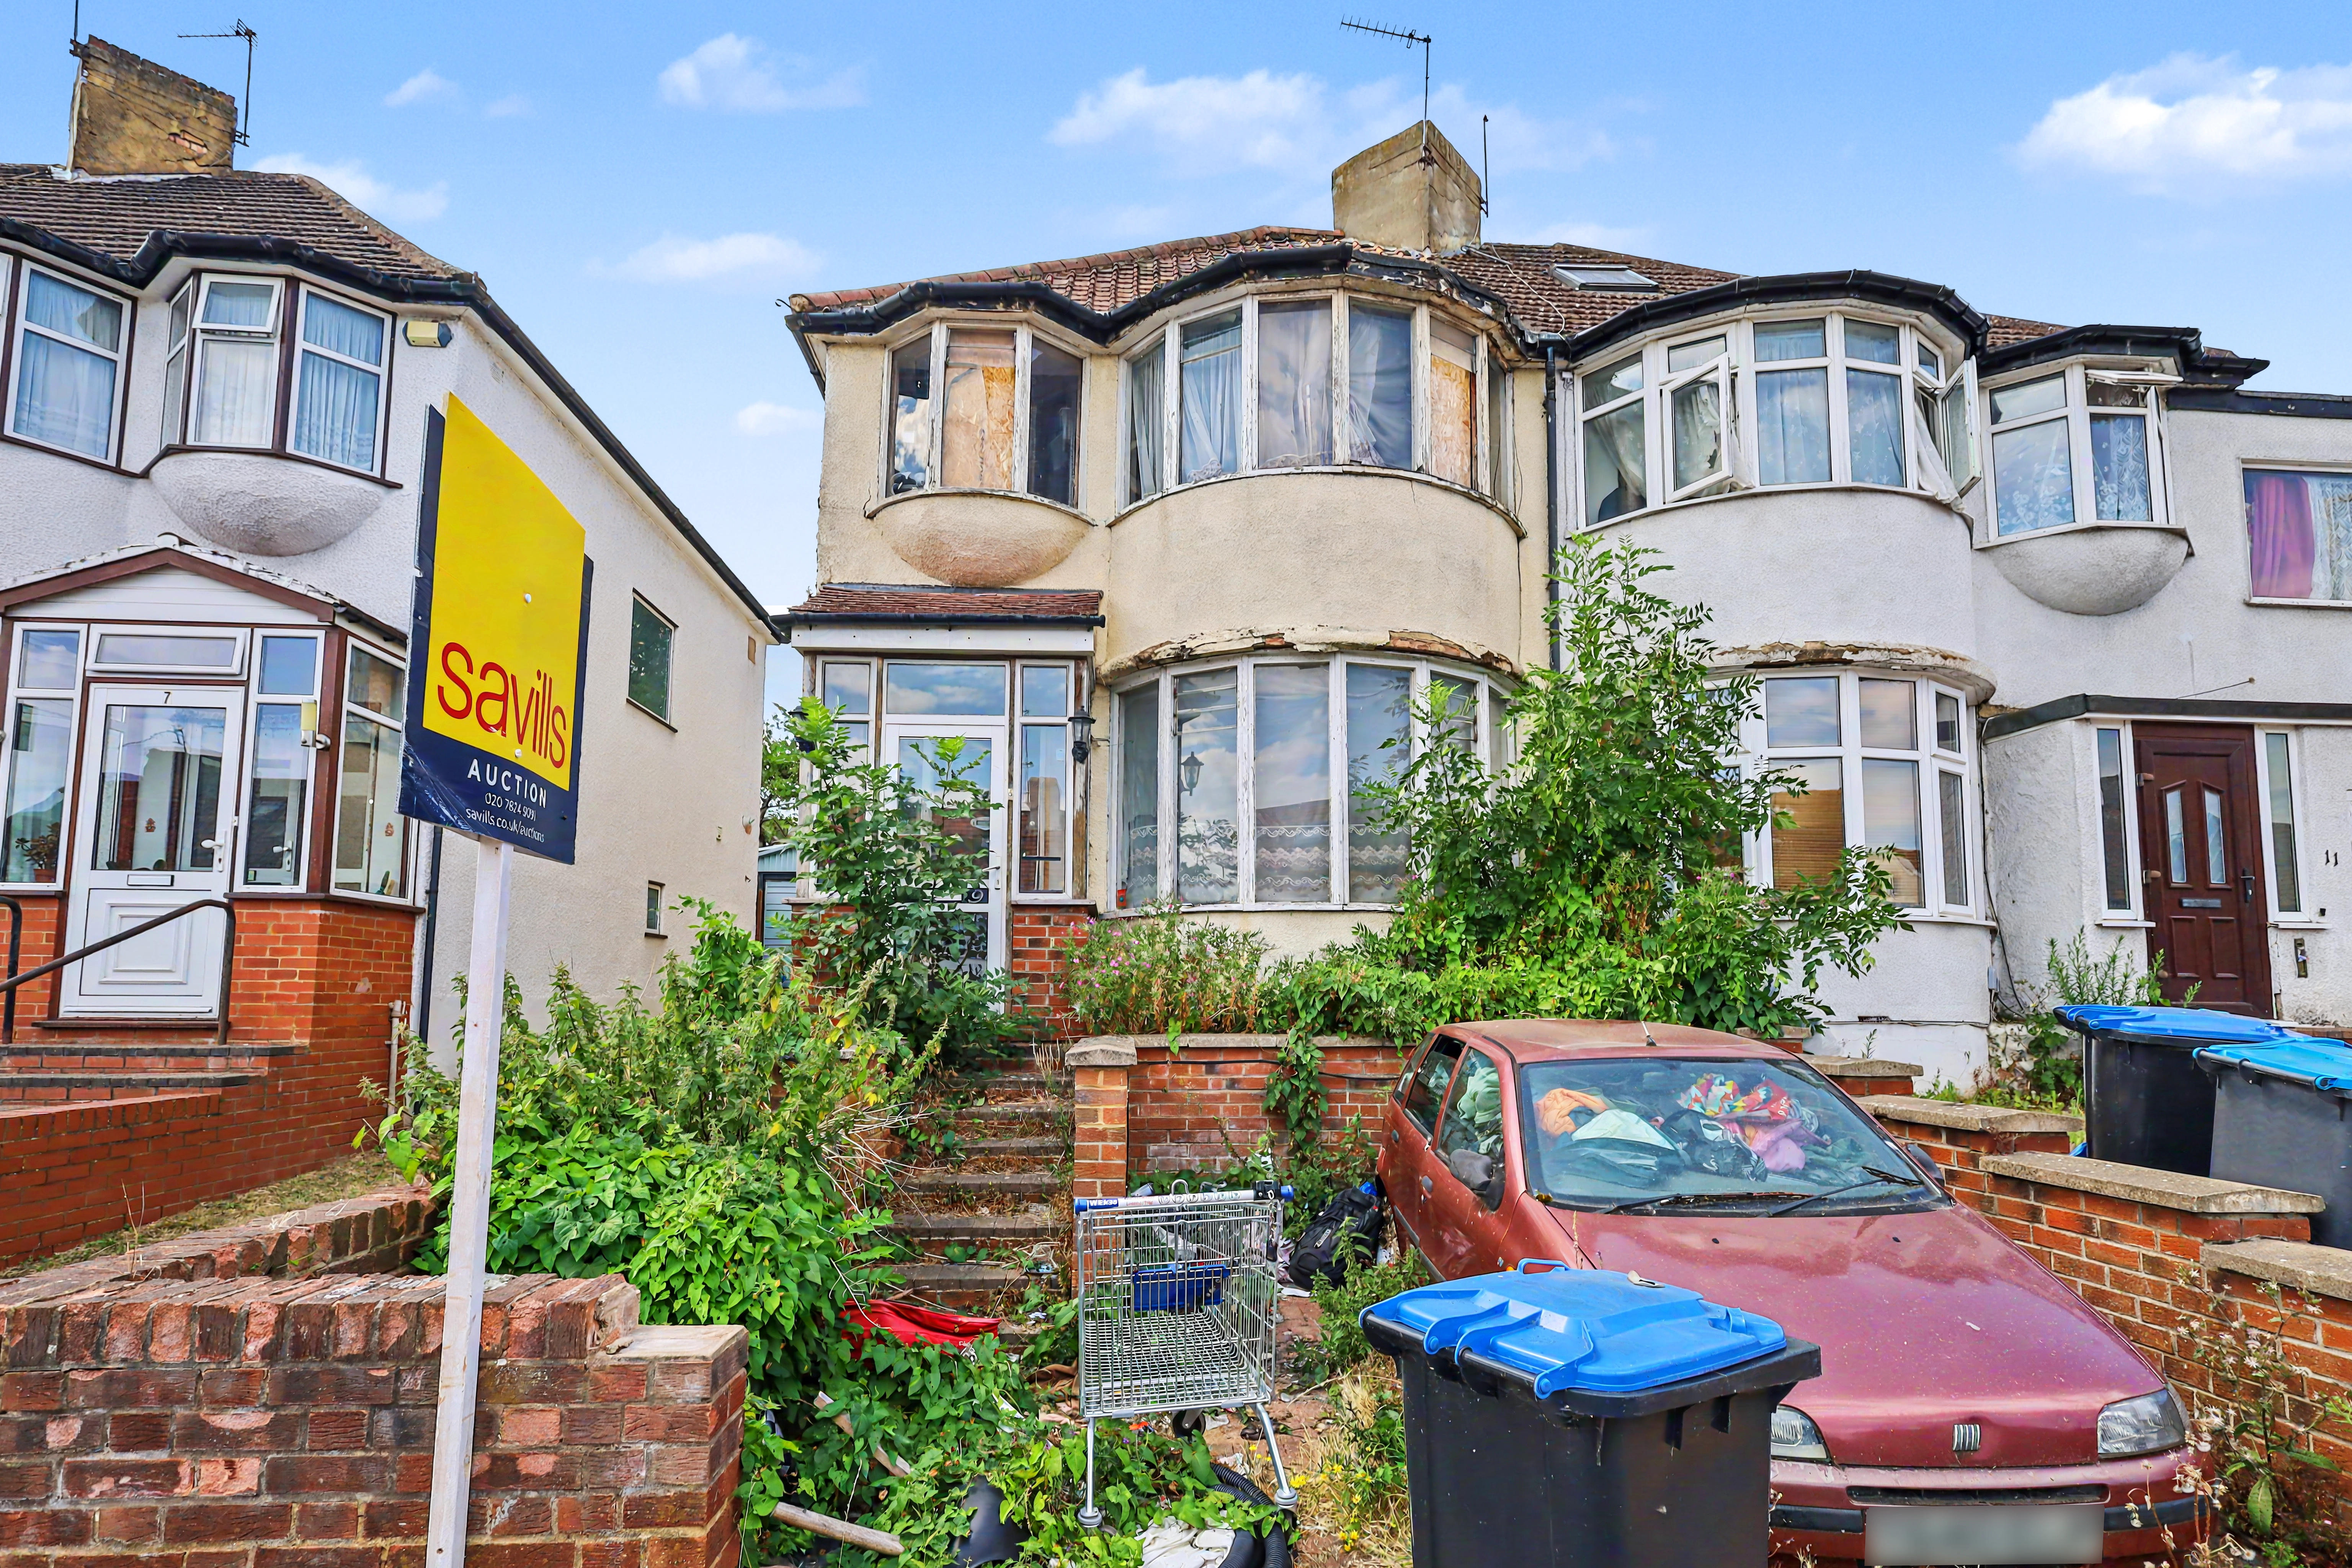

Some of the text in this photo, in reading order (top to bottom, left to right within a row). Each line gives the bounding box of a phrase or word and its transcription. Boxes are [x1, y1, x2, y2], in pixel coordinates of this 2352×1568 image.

[164, 691, 171, 704] 7
[438, 642, 567, 768] savills
[467, 758, 547, 808] AUCTION
[485, 792, 503, 808] 020
[505, 798, 521, 815] 7824
[2325, 849, 2338, 867] 11
[967, 889, 984, 903] 9
